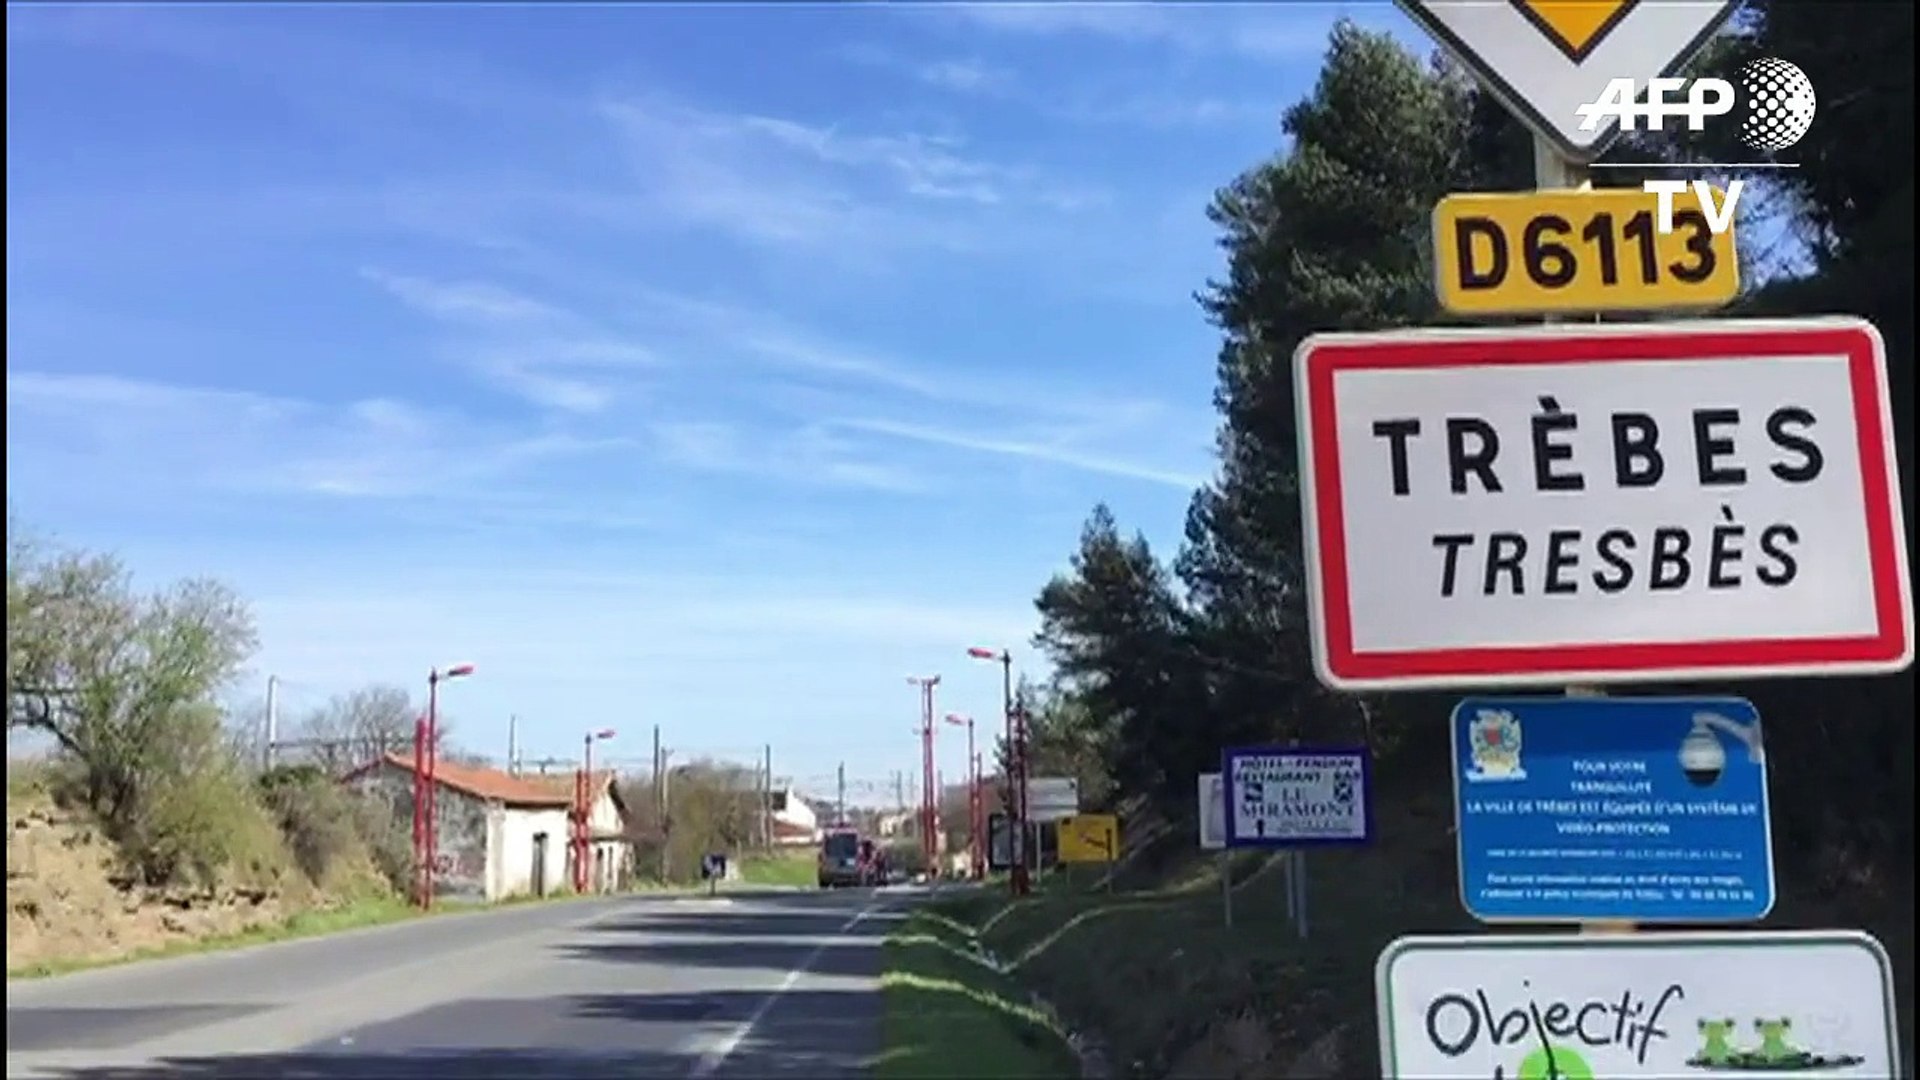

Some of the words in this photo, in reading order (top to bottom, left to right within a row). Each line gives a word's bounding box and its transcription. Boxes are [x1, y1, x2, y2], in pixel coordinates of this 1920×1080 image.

[1373, 395, 1825, 496] TRÈBES
[1432, 505, 1800, 597] TRESBÈS
[1240, 803, 1355, 818] MIRAMONT
[1426, 980, 1684, 1075] Objectif
